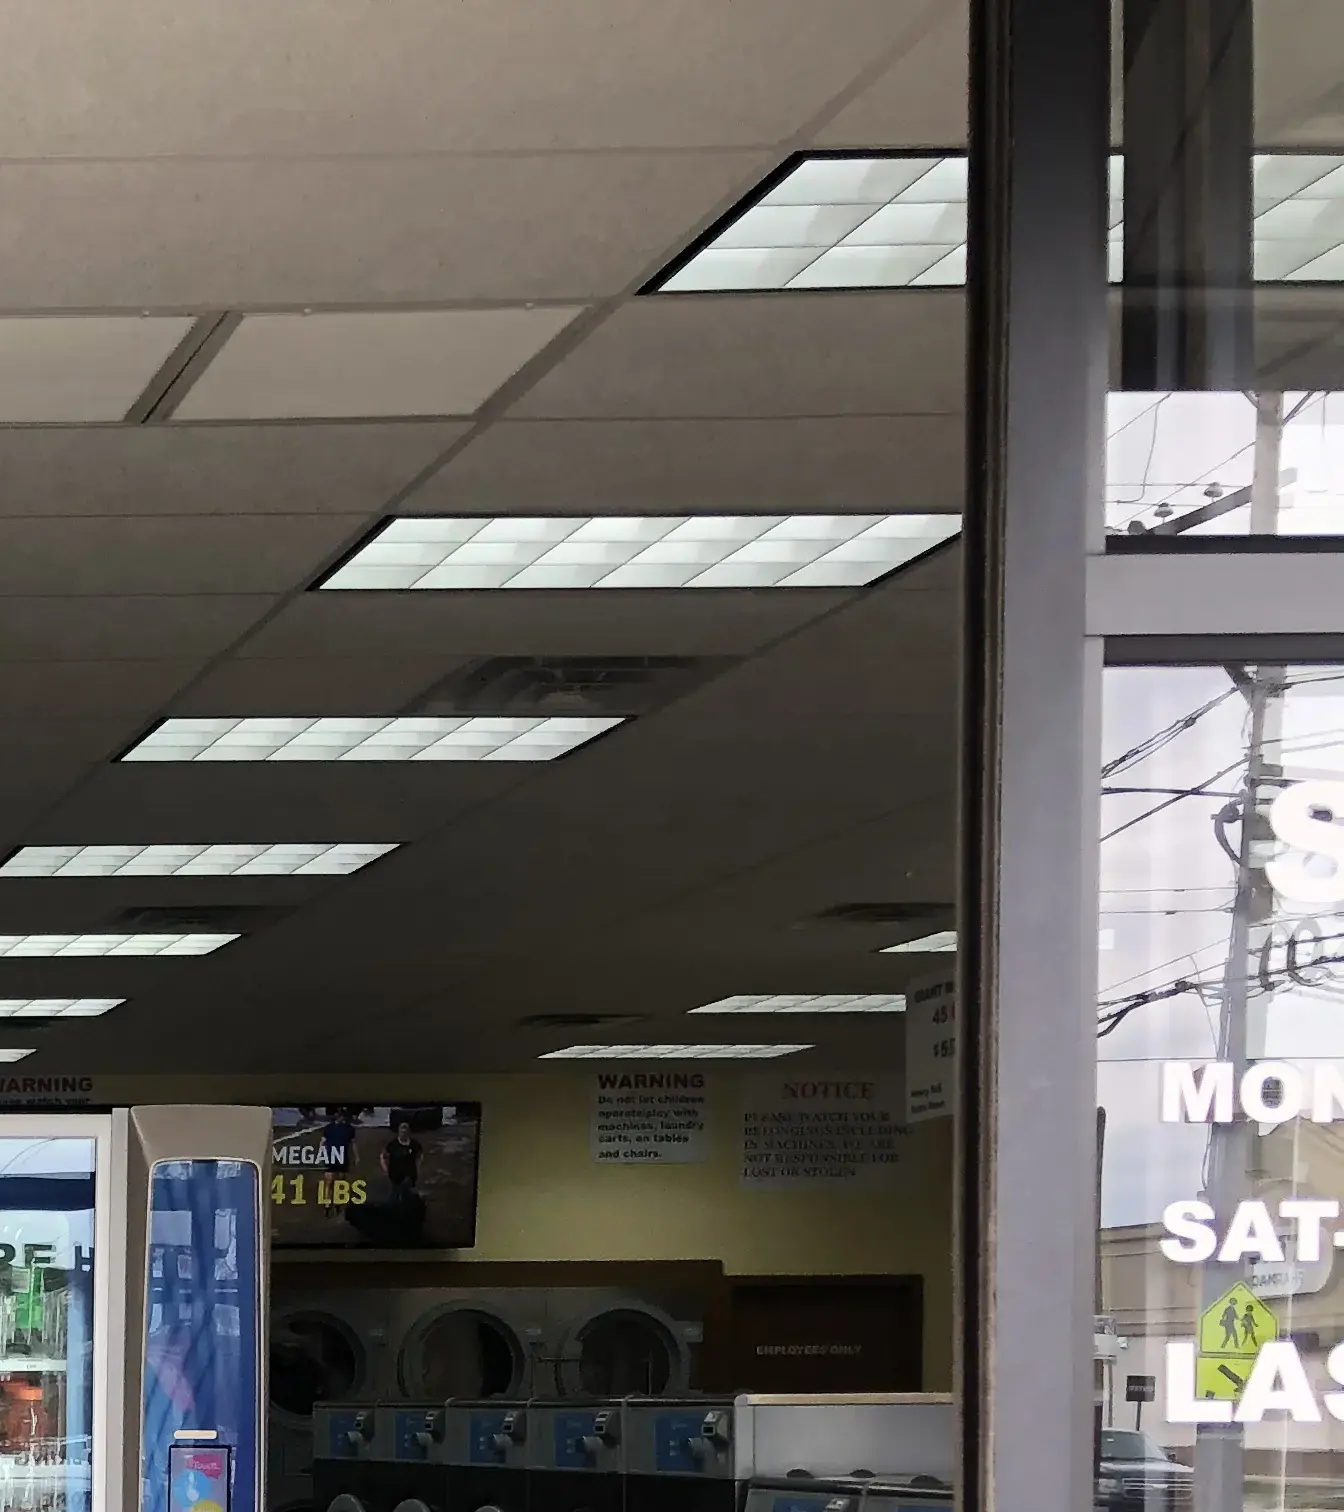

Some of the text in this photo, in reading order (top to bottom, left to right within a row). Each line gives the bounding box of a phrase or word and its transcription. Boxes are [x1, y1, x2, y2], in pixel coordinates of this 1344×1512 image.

[598, 1074, 704, 1089] WARNING
[782, 1081, 875, 1099] NOTICE
[272, 1146, 345, 1165] MEGAN
[317, 1179, 367, 1205] LBS
[755, 1344, 862, 1355] EMPLOYEES ONLY
